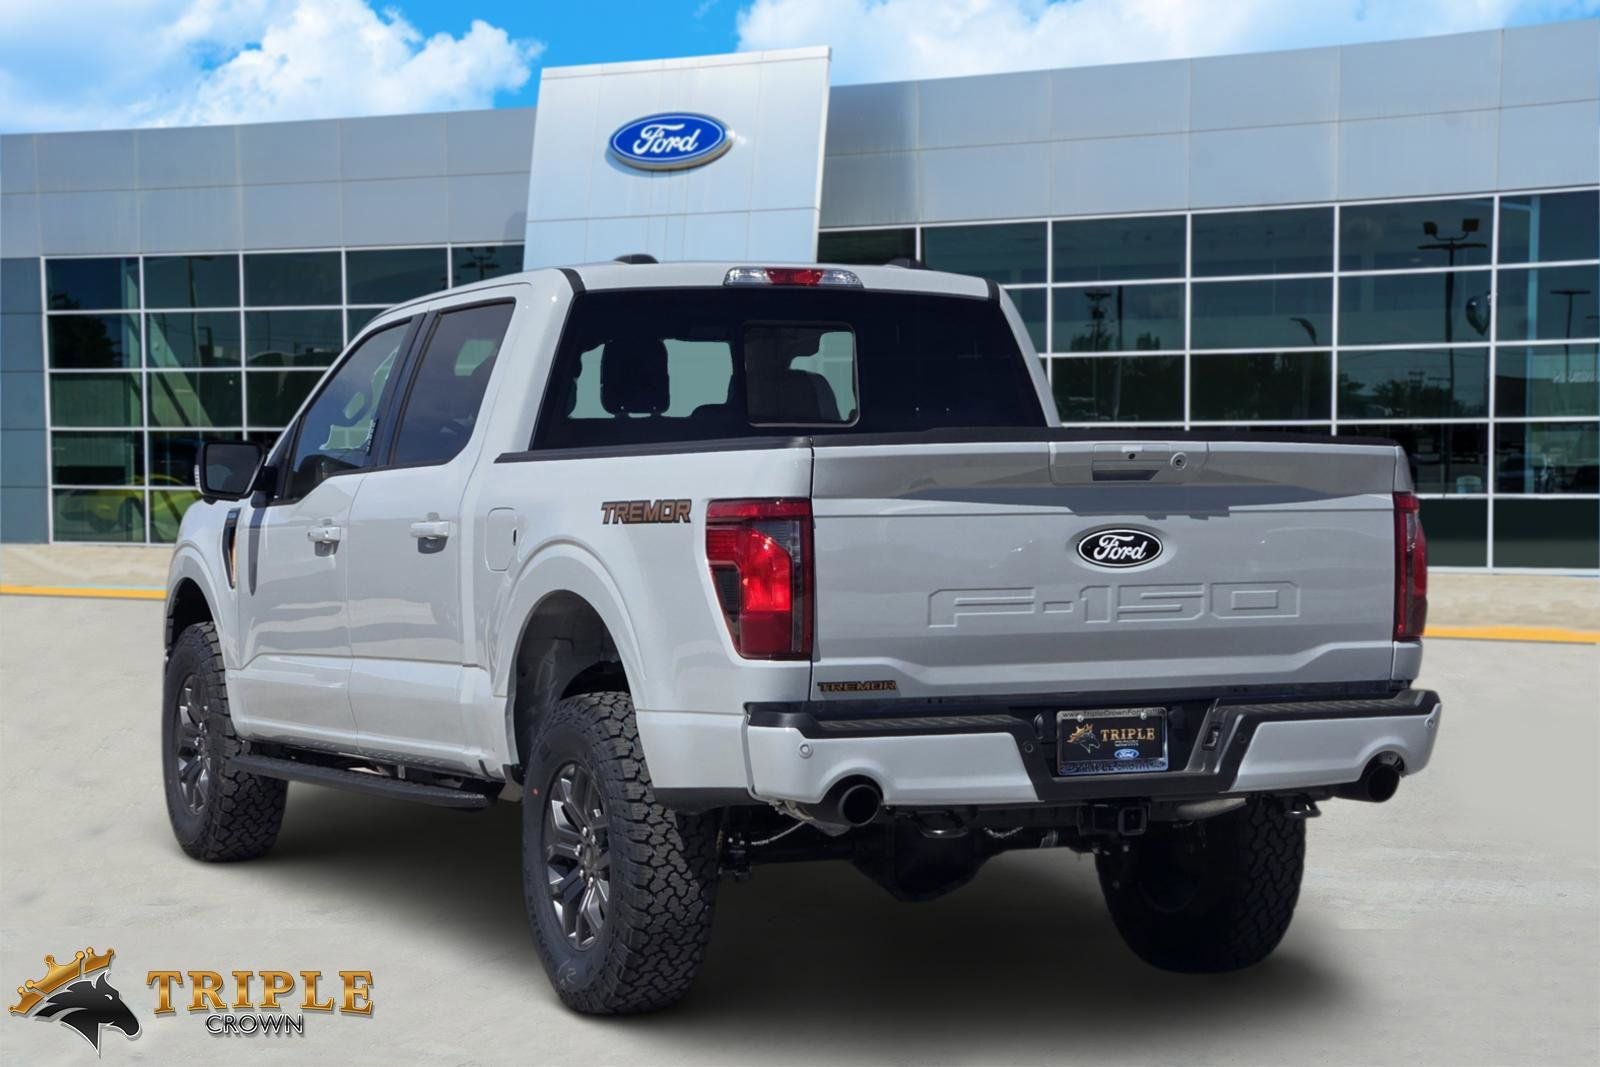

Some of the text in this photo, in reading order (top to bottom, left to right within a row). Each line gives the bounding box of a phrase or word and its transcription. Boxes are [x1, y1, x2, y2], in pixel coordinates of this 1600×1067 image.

[632, 123, 701, 155] Ford
[601, 499, 692, 524] TREMOR
[1093, 534, 1148, 560] Ford
[928, 580, 1300, 628] F-150
[817, 680, 897, 692] TREMOR
[1100, 728, 1155, 741] TRIPLE
